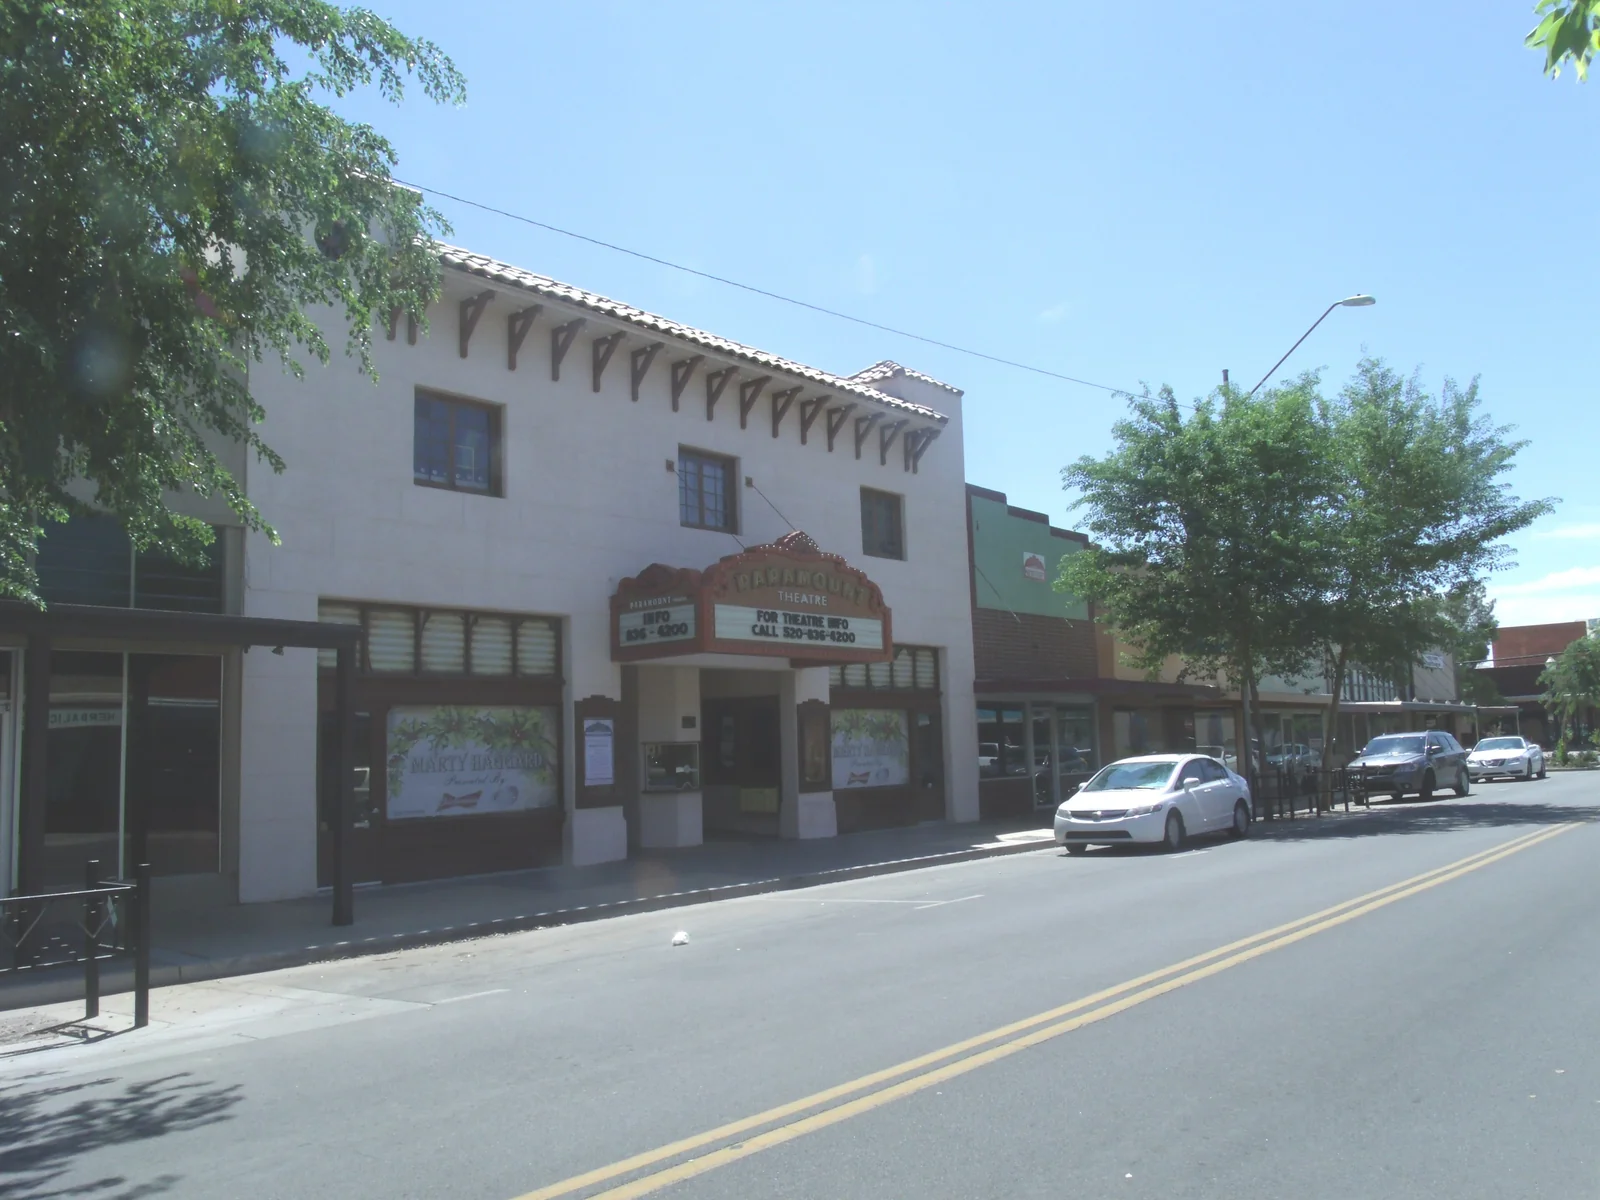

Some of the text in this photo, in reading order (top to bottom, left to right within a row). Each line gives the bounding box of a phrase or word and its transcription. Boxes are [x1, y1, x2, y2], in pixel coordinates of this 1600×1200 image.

[733, 567, 865, 606] PARAMOUNT
[629, 596, 671, 609] PARAMOUNT
[778, 590, 828, 606] THEATRE
[643, 610, 670, 625] INFO
[756, 609, 849, 630] FOR THEATRE INFO
[751, 624, 856, 643] CALL 520-836-4200
[410, 753, 469, 774] MARTY
